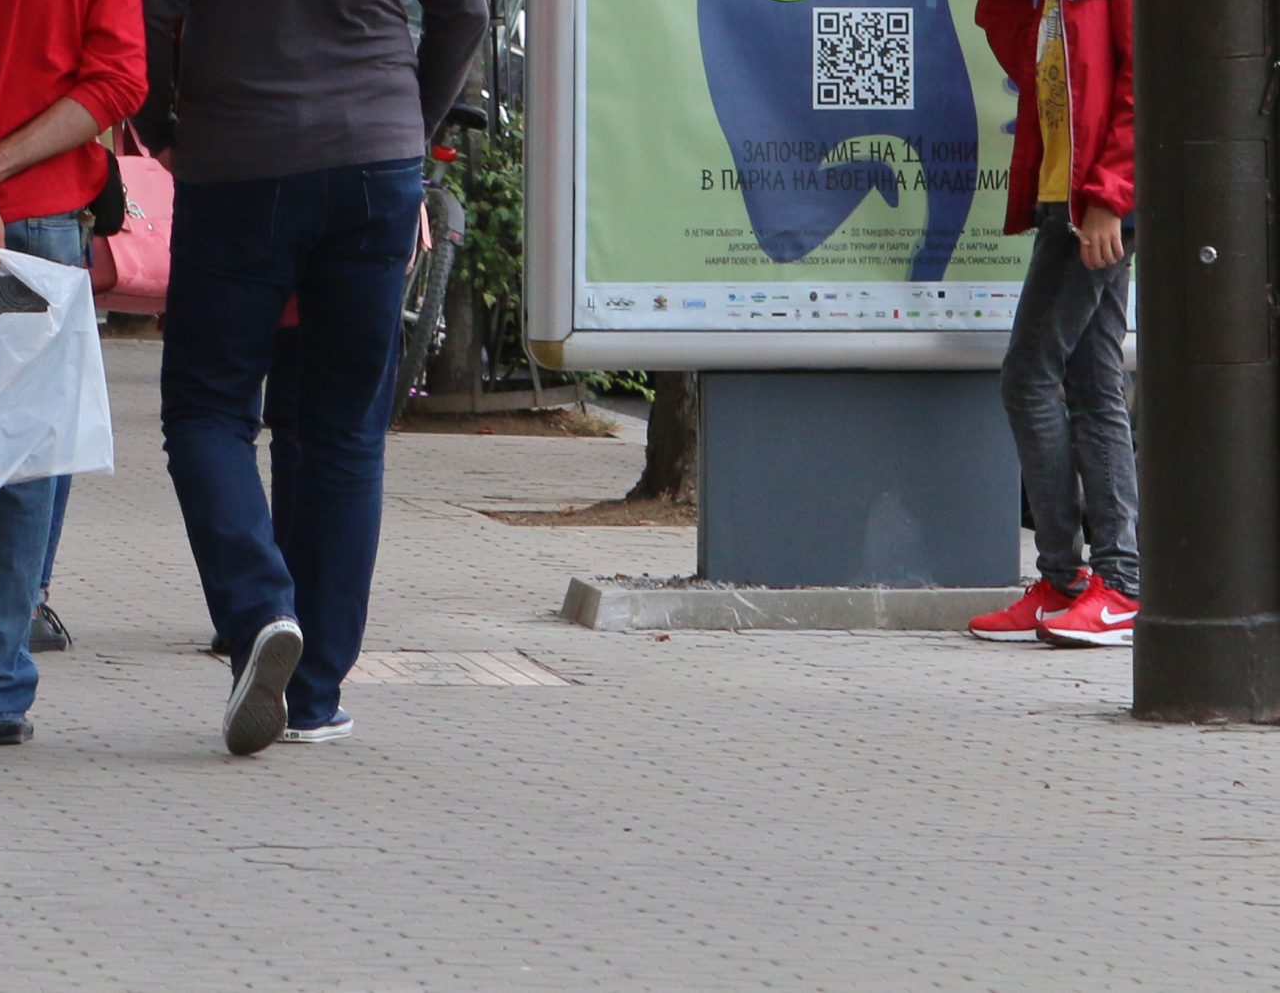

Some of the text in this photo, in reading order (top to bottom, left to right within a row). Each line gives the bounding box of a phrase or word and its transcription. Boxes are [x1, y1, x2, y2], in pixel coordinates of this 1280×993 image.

[743, 136, 979, 164] ЗАПОЧВАМЕ НА 11 ЮНИ
[701, 169, 1010, 193] В ПАРКА НА ВОЕННА АКАДЕМИ
